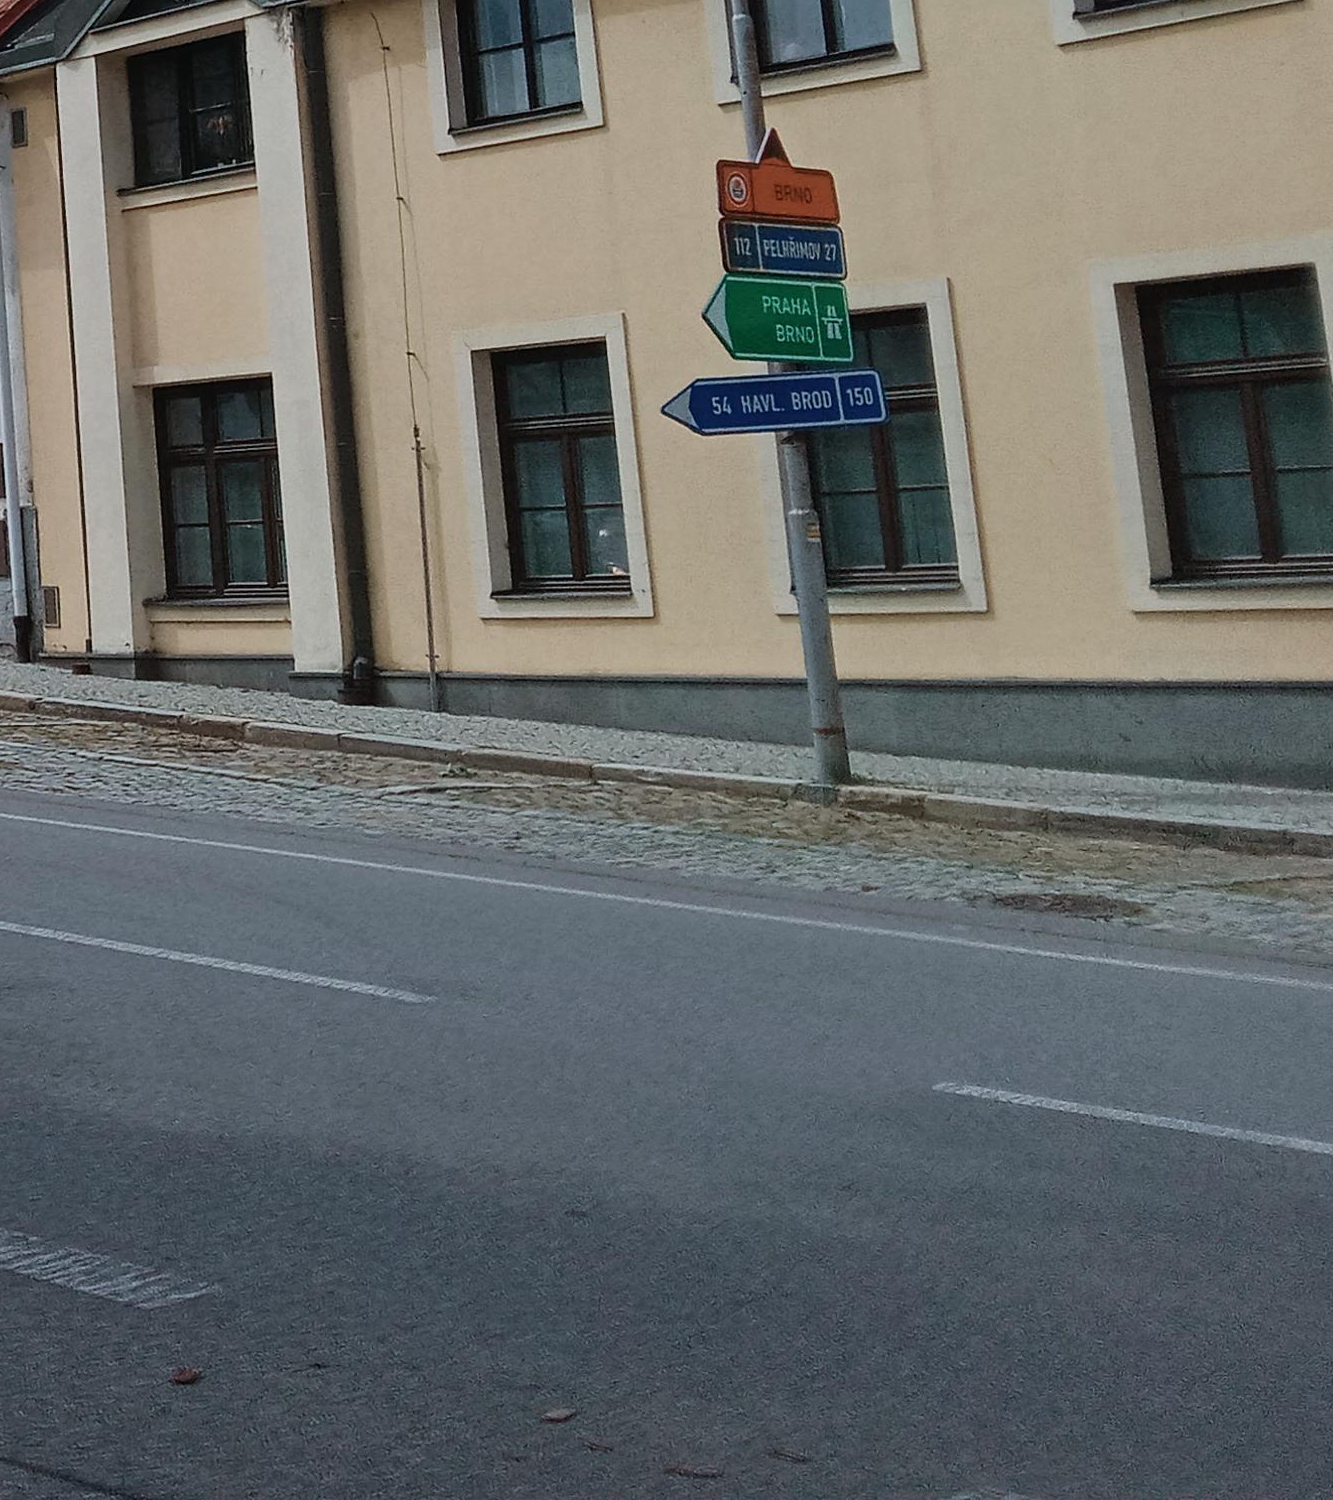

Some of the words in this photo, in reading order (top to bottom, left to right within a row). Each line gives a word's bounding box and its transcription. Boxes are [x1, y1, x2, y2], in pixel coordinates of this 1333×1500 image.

[774, 184, 813, 204] BRNO
[733, 237, 752, 256] 112
[763, 236, 821, 260] PELHŘIMOV
[824, 244, 837, 261] 27
[762, 295, 812, 316] PRAHA
[775, 324, 815, 343] BRNO
[711, 396, 733, 415] 54
[740, 394, 785, 414] HAVL.
[791, 390, 833, 411] BROD
[846, 387, 874, 407] 150
